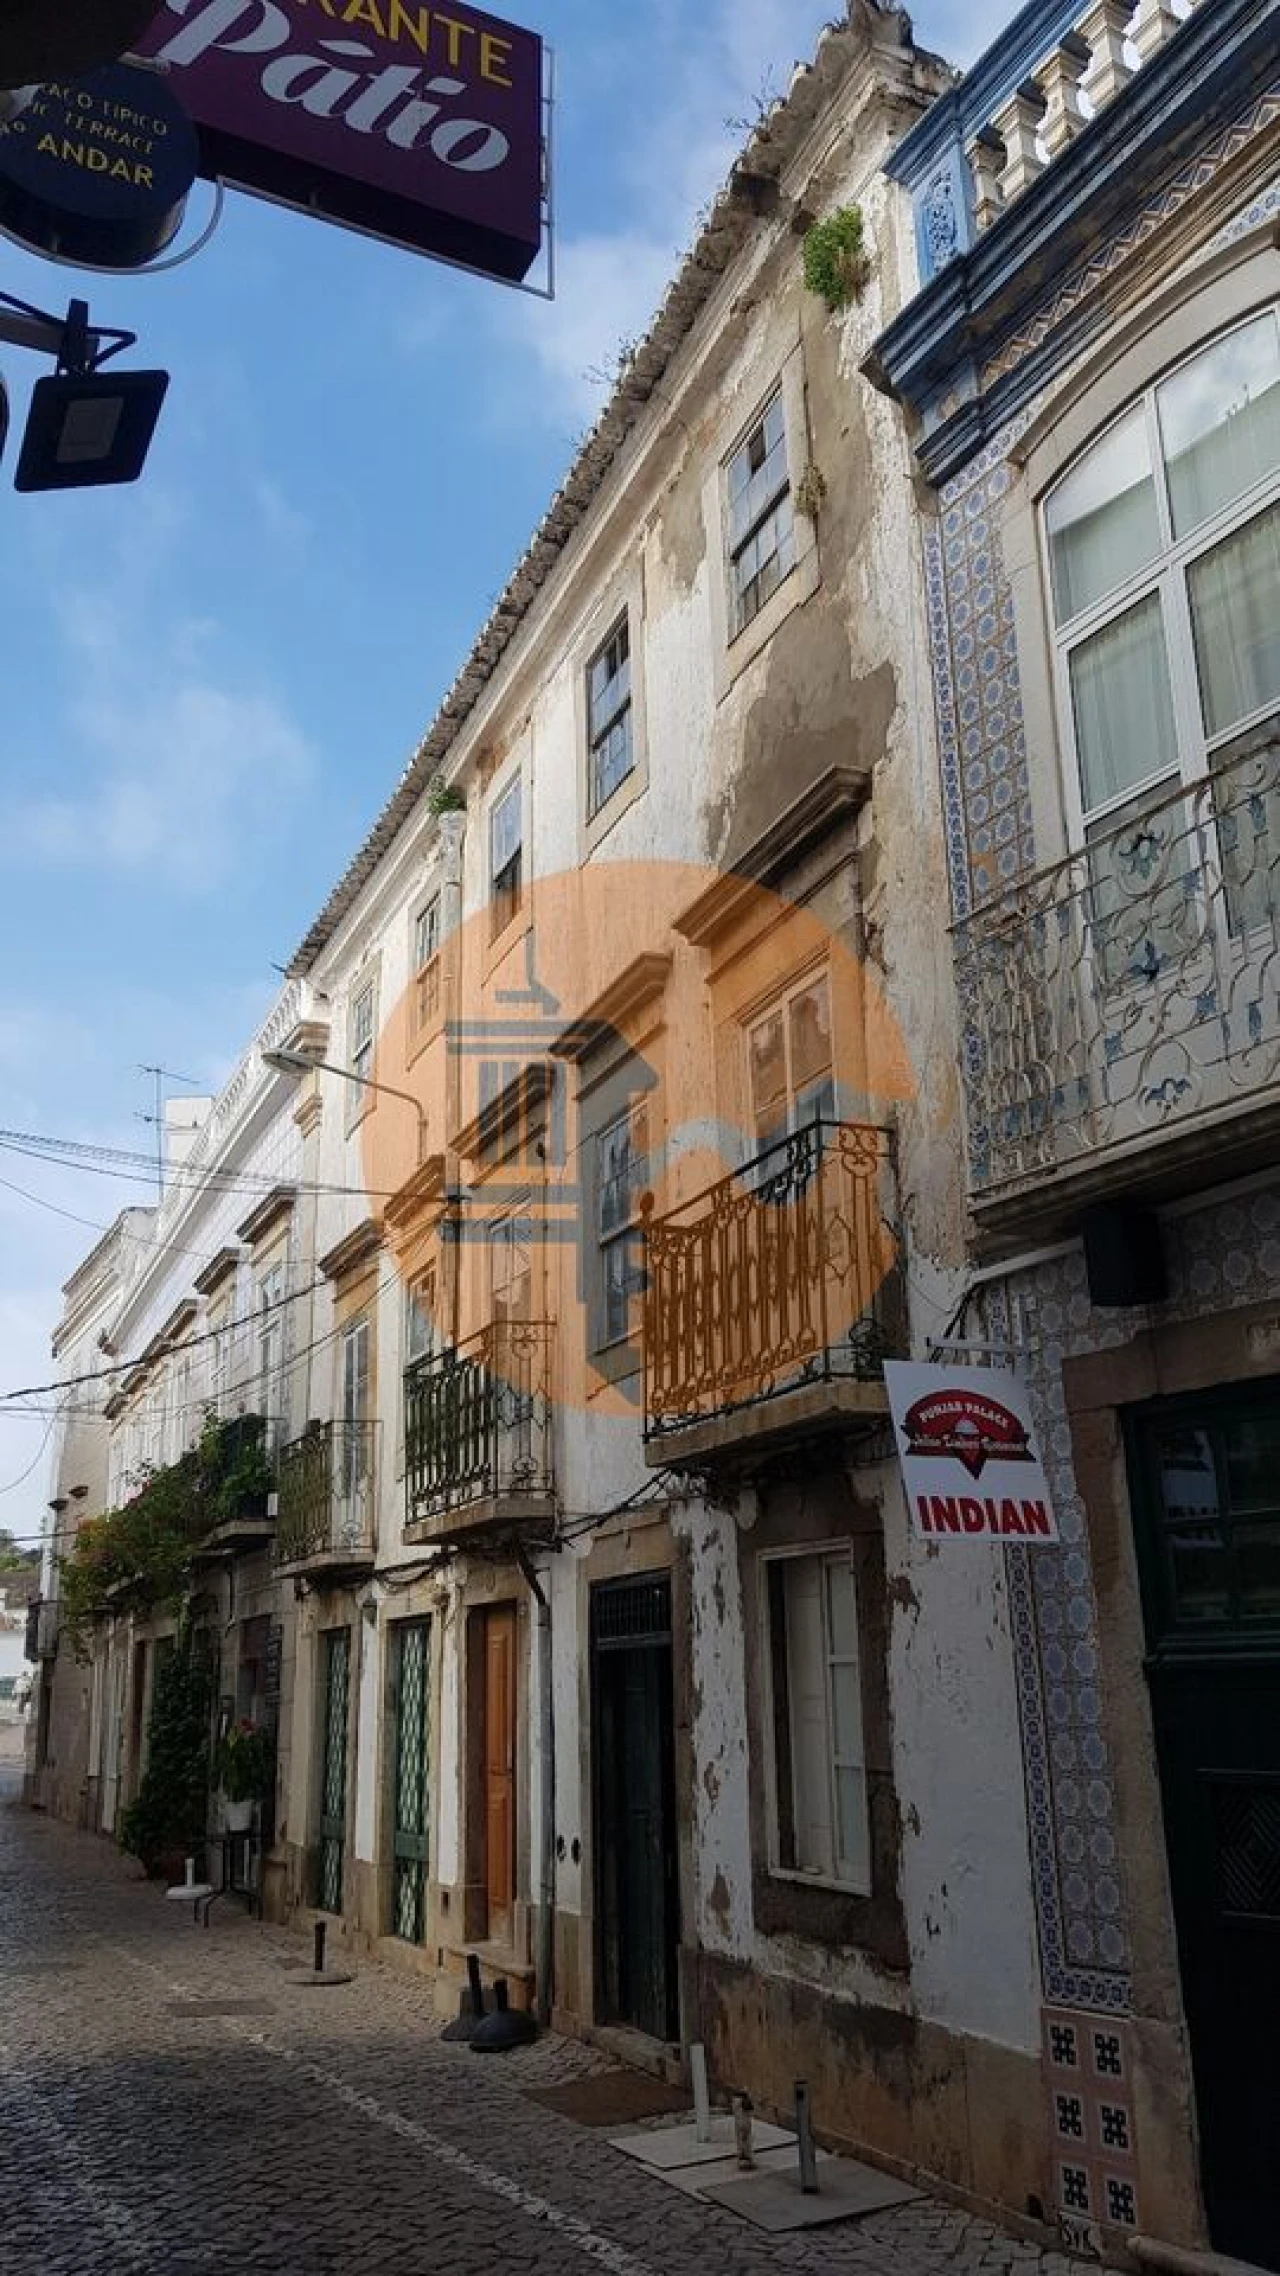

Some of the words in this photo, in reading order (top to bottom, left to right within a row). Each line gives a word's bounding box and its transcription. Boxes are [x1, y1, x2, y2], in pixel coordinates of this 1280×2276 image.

[37, 132, 153, 190] ANDAR
[919, 1401, 964, 1424] PUNJAB
[965, 1403, 1010, 1429] PALACE
[916, 1495, 1052, 1535] INDIAN
